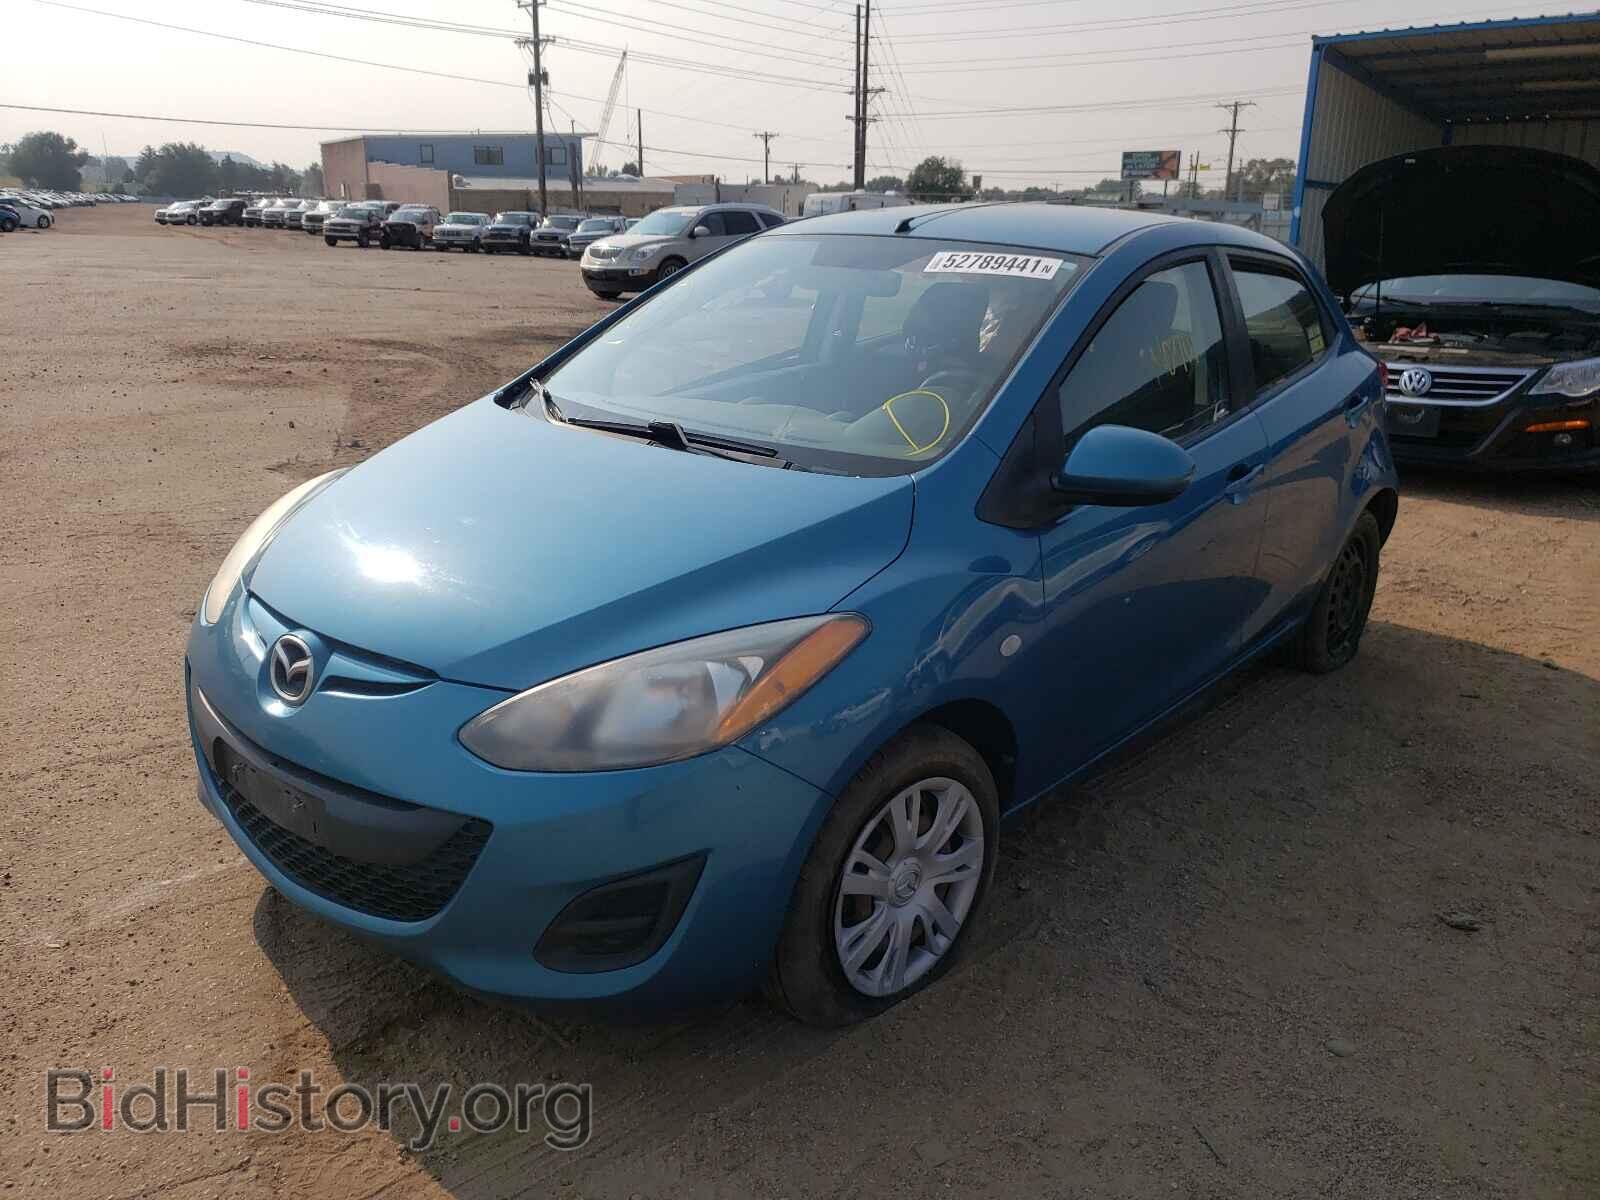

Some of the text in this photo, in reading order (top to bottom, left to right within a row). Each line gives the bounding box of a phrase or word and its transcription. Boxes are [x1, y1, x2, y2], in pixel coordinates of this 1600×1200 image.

[943, 254, 1041, 272] 52789441
[1399, 367, 1432, 396] VW
[882, 390, 950, 456] D
